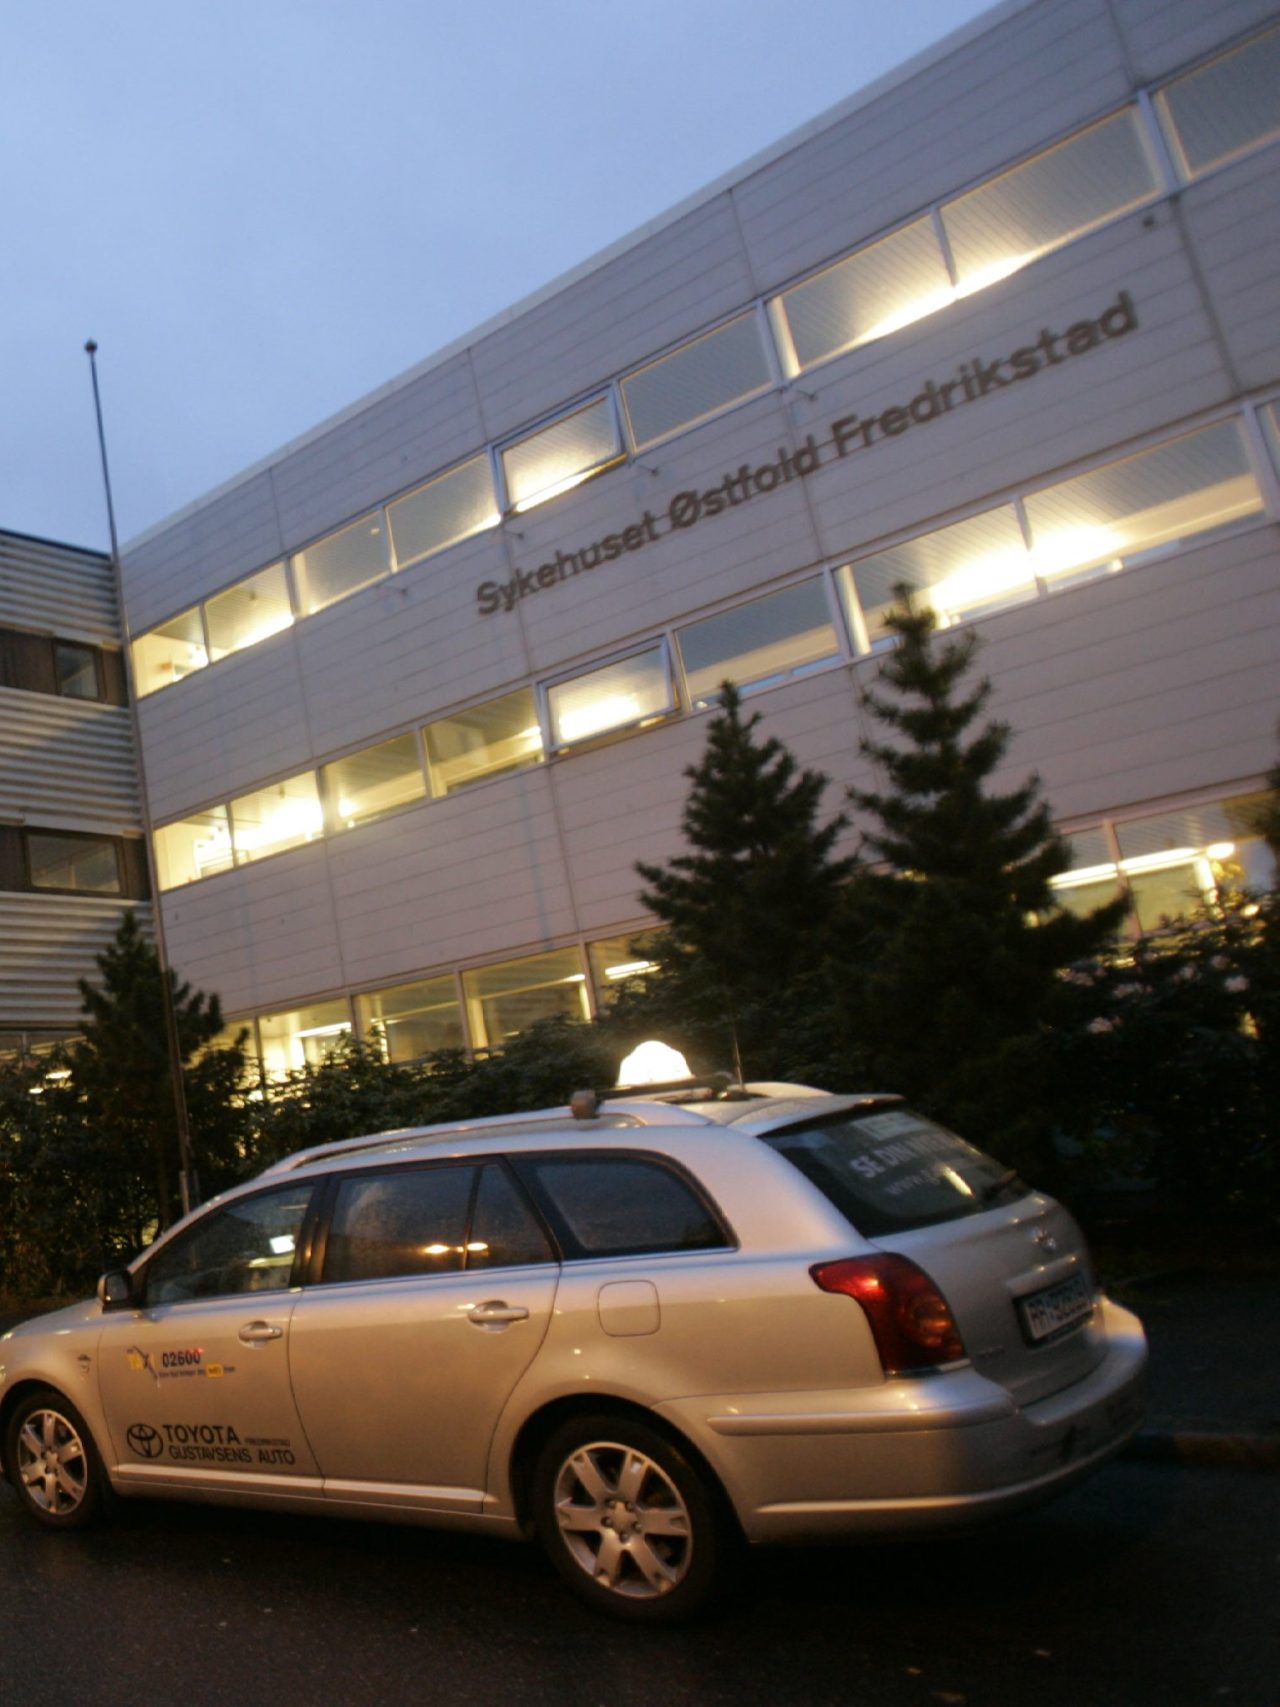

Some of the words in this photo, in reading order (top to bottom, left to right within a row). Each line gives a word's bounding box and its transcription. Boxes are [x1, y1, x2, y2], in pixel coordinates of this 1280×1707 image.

[475, 511, 660, 616] Sykehuset
[667, 435, 822, 530] Østfold
[830, 290, 1139, 459] Fredrikstad
[162, 1350, 202, 1368] 02600
[162, 1424, 241, 1445] TOYOTA
[168, 1445, 252, 1463] GUSTAVSENS
[258, 1447, 296, 1465] AUTO
